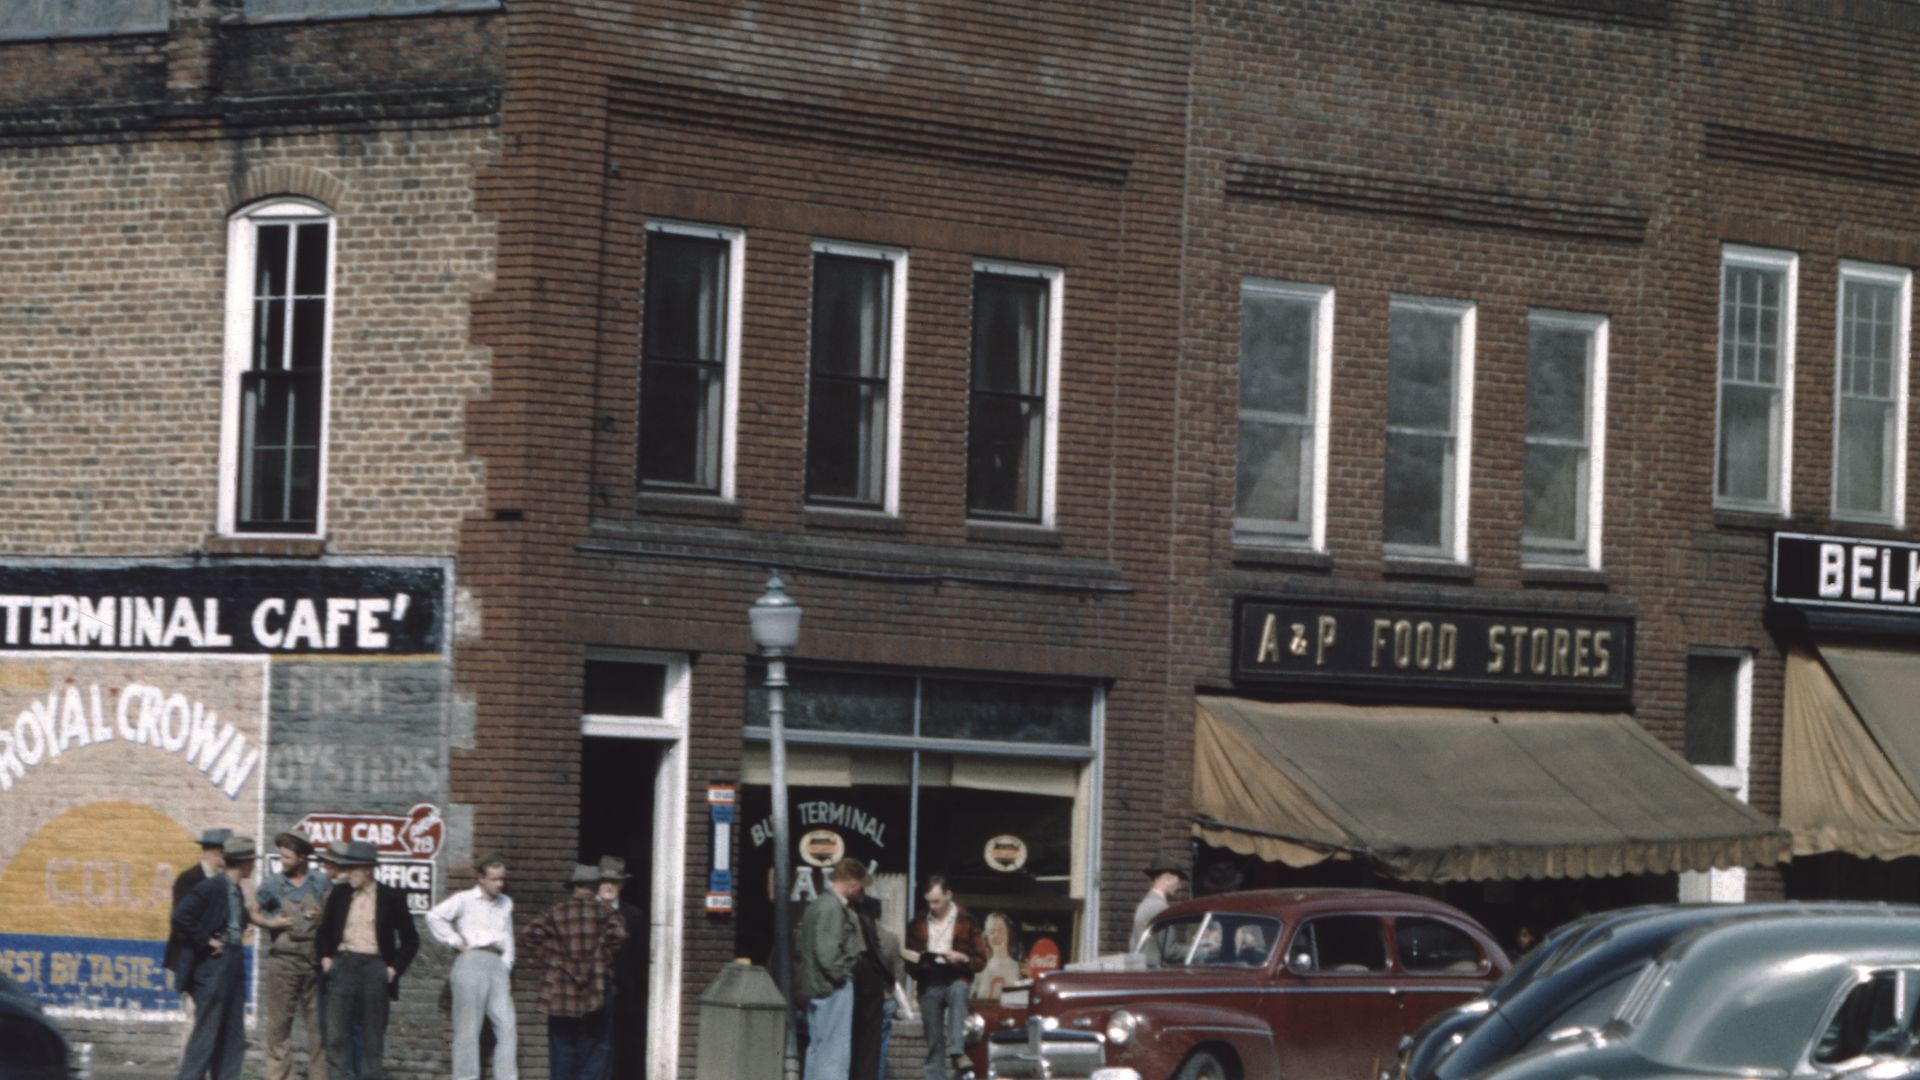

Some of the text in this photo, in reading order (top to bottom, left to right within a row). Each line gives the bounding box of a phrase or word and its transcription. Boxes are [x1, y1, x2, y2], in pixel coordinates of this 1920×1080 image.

[0, 595, 233, 647] TERMINAL
[1257, 613, 1612, 678] A & P FOOD STORES
[0, 682, 260, 798] ROYAL CROWN
[301, 820, 395, 845] TAXI CAB
[797, 801, 886, 848] TERMINAL
[46, 858, 174, 913] COLA
[51, 952, 82, 985] BY
